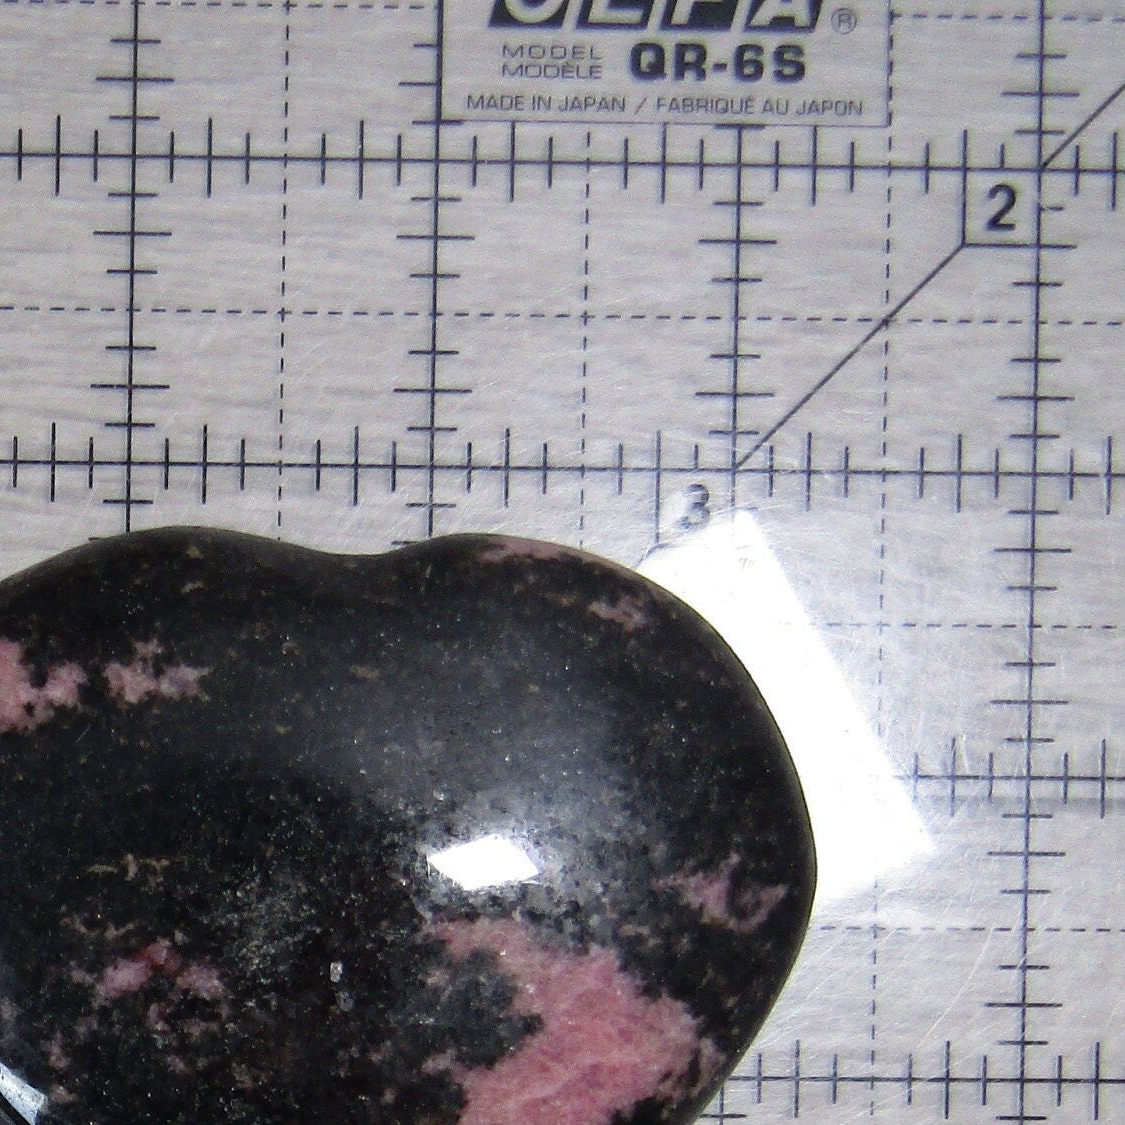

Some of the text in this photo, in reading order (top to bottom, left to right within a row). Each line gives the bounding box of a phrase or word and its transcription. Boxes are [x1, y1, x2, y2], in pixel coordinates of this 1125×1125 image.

[501, 45, 603, 60] MODEL
[629, 42, 806, 83] QR-6S
[501, 61, 603, 80] MODÈLE
[466, 94, 525, 111] MADE
[531, 95, 552, 112] IN
[558, 95, 626, 113] JAPAN
[761, 98, 790, 116] AU
[795, 98, 863, 117] JAPON
[986, 184, 1018, 232] 2
[676, 483, 712, 530] 3
